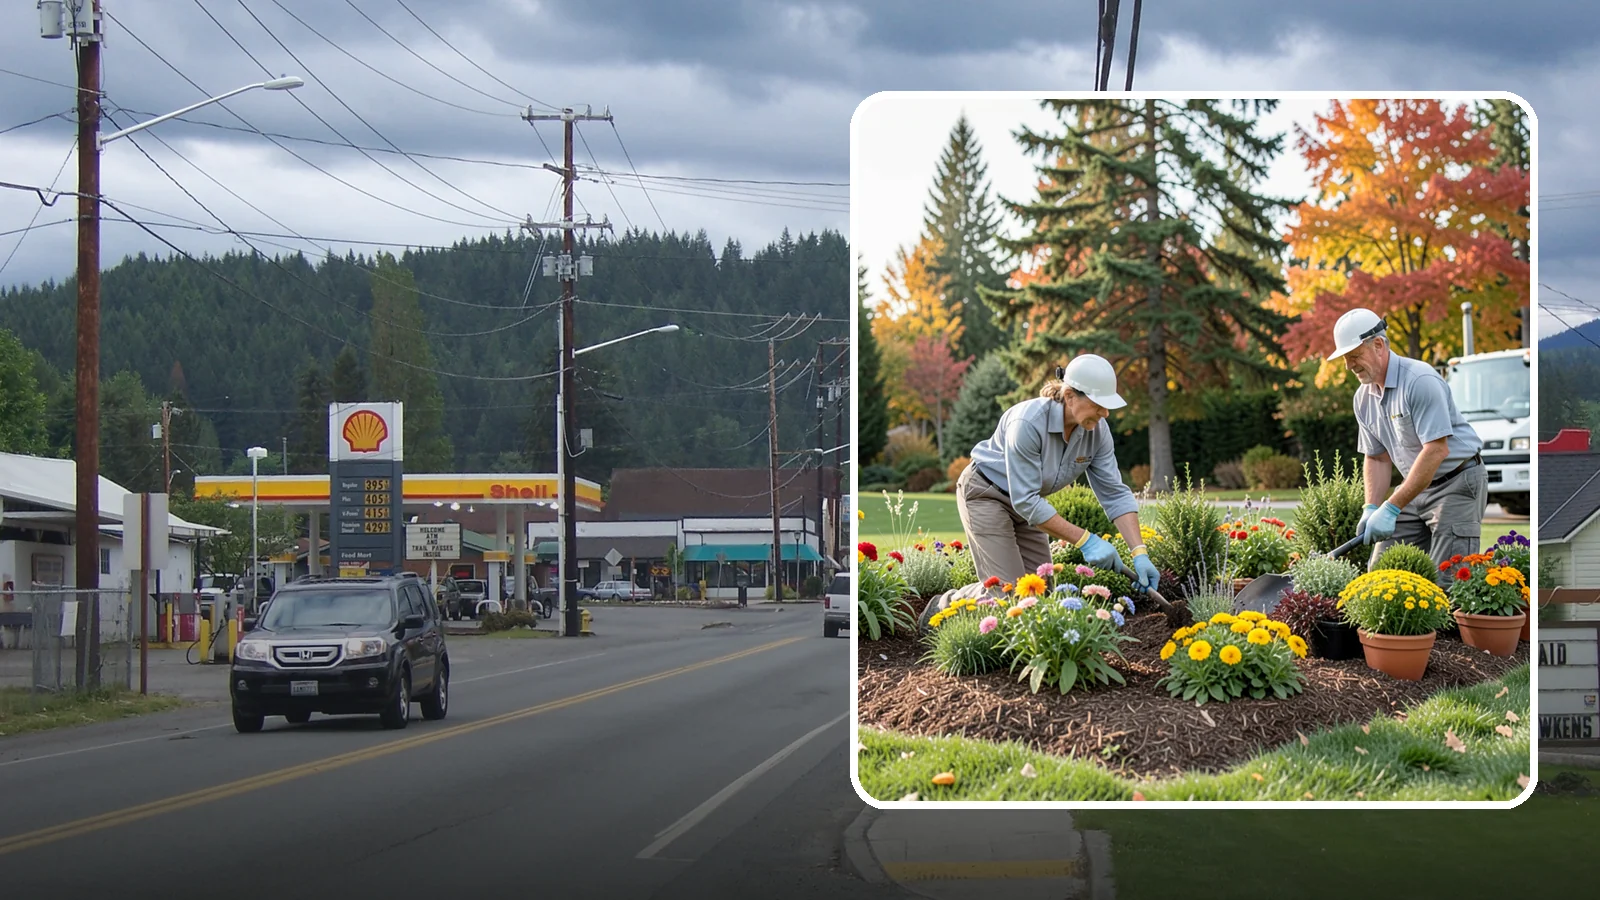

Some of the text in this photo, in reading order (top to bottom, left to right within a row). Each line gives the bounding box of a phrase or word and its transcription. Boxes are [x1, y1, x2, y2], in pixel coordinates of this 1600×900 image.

[366, 480, 383, 490] 395
[490, 484, 547, 499] Shell
[366, 494, 383, 504] 405
[366, 508, 383, 518] 415
[366, 522, 383, 532] 429
[1538, 642, 1566, 666] AID
